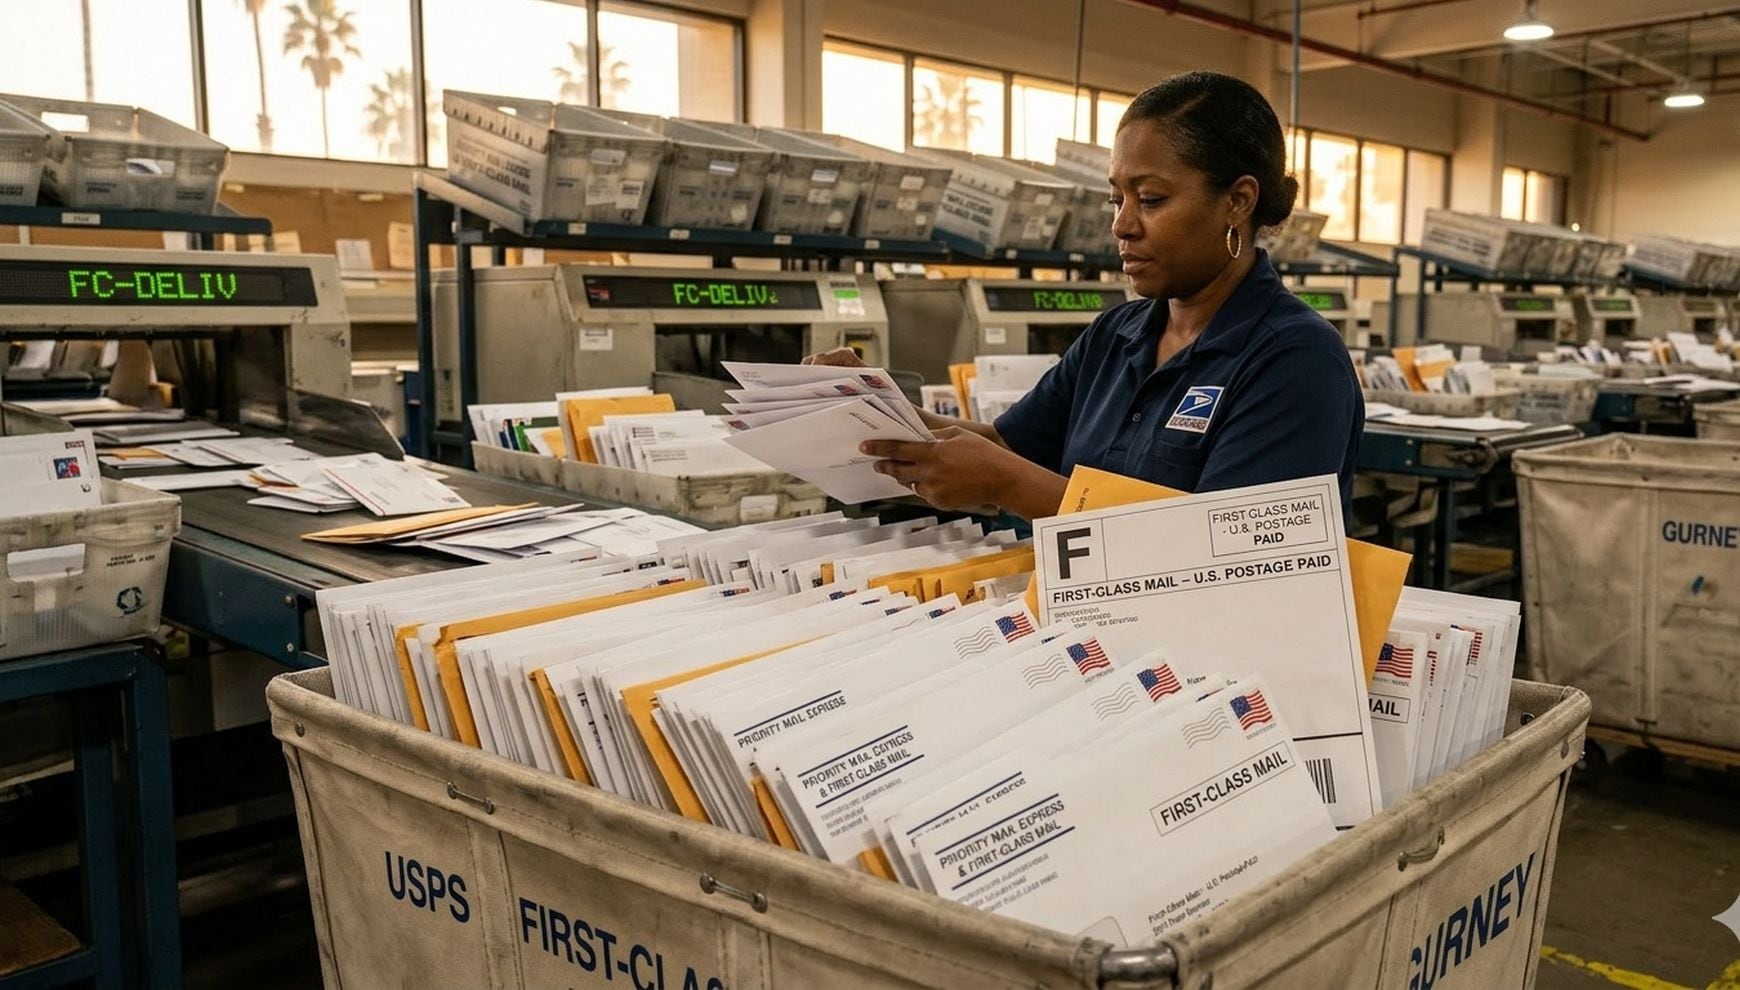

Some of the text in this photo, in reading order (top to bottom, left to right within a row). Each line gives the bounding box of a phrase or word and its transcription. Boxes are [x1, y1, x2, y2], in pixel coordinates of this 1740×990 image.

[69, 270, 237, 299] FC-DELIV
[1213, 510, 1246, 523] FIRST
[1255, 514, 1312, 531] POSTAGE
[1254, 532, 1285, 545] PAID
[1662, 520, 1740, 549] GURNE
[1057, 527, 1091, 579] F
[1145, 576, 1178, 591] MAIL
[1194, 570, 1222, 584] U.S.
[1225, 559, 1294, 579] POSTAGE
[1297, 555, 1332, 569] PAID
[1160, 751, 1288, 826] FIRST-CLASS MAIL
[385, 851, 470, 923] USPS
[519, 897, 725, 990] FIRST-CLA
